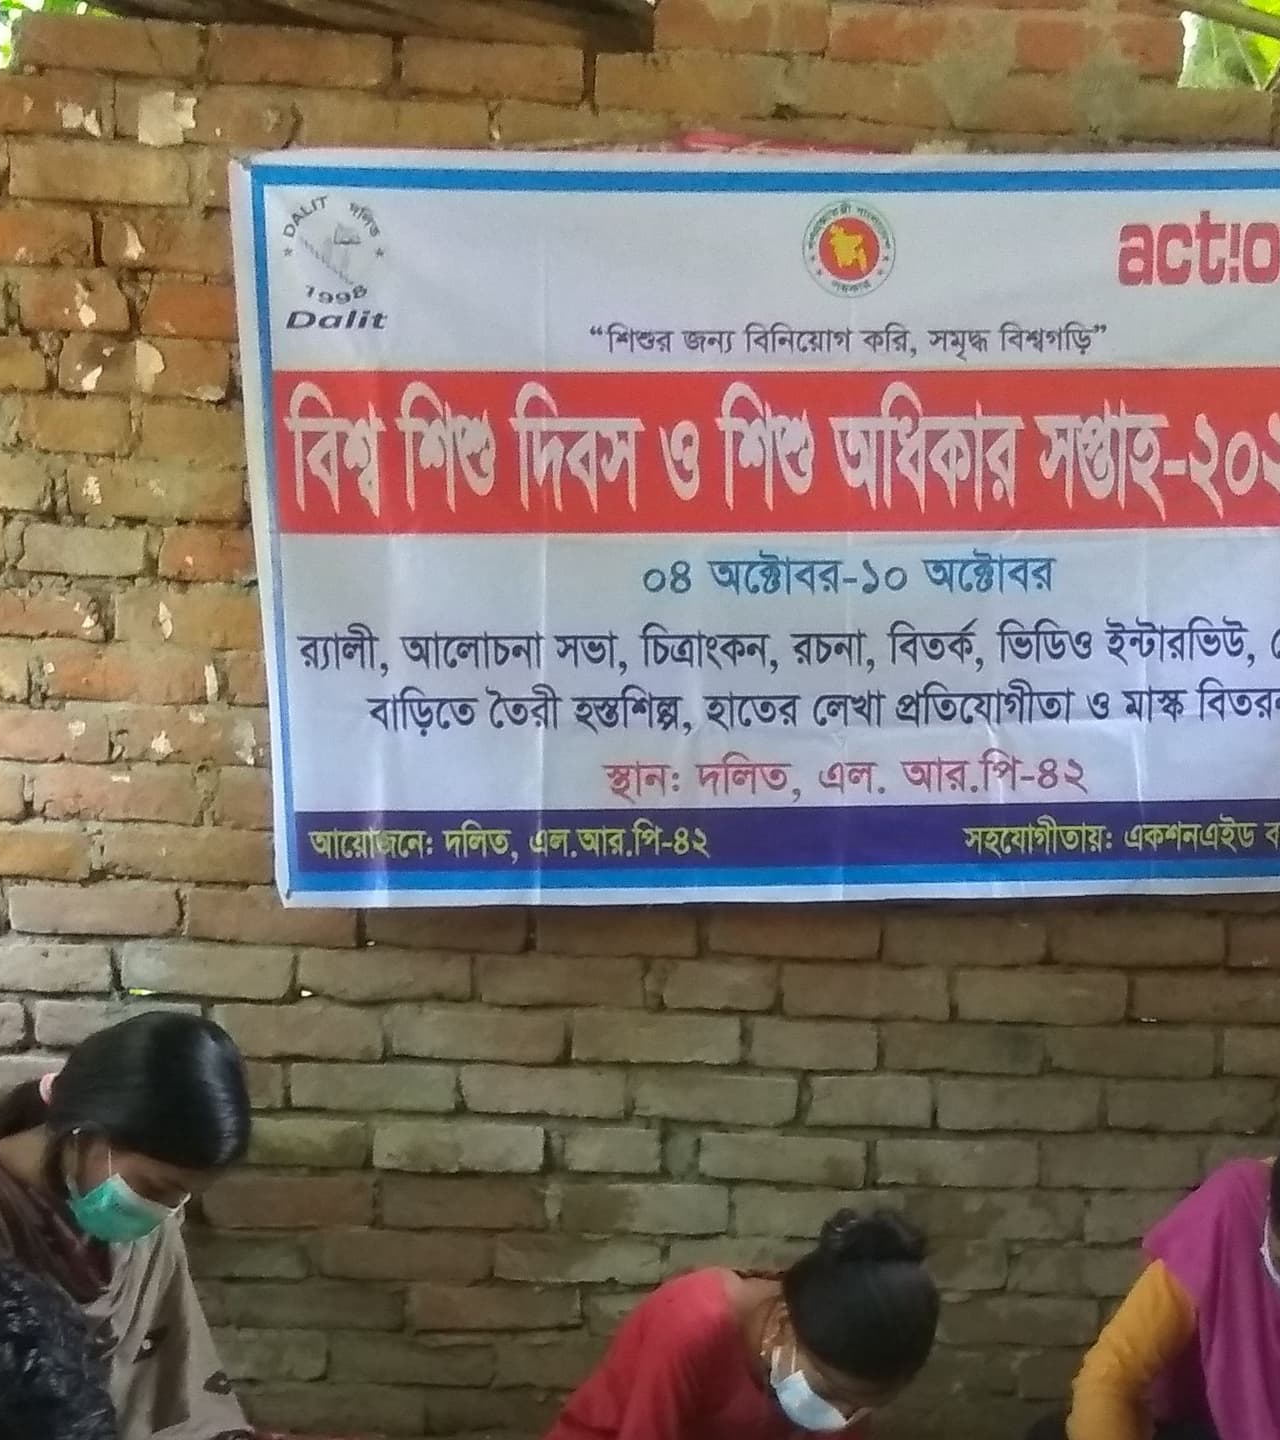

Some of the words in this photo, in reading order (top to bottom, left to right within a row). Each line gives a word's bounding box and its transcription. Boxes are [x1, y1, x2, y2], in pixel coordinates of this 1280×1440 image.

[282, 194, 328, 239] DALIT
[348, 201, 381, 238] দলিত
[307, 283, 367, 304] 1998
[286, 309, 388, 329] Dalit
[681, 330, 736, 353] জন্য
[743, 322, 853, 353] বিনিয়োগ
[859, 322, 916, 357] করি,
[928, 329, 991, 359] সমৃদ্ধ
[284, 383, 385, 517] বিশ্ব
[396, 383, 495, 512] শিশু
[509, 383, 645, 512] দিবস
[659, 420, 700, 500] ও
[715, 383, 814, 510] শিশু
[829, 382, 1024, 513] অধিকার
[643, 560, 691, 594] ০৪
[921, 549, 1057, 593] অক্টোবর
[399, 631, 545, 669] আলোচনা
[553, 630, 627, 676] সভা,
[638, 622, 778, 674] চিত্রাংকন,
[790, 628, 875, 673] রচনা,
[886, 618, 984, 672] বিতর্ক,
[996, 618, 1092, 663] ভিডিও
[1105, 616, 1255, 668] ইন্টারভিউ,
[366, 686, 479, 737] বাড়িতে
[485, 683, 563, 730] তৈরী
[571, 684, 692, 736] হস্তশিল্প,
[703, 691, 802, 732] হাতের
[813, 689, 886, 728] লেখা
[895, 678, 1076, 728] প্রতিযোগীতা
[1086, 692, 1109, 720] ও
[1121, 685, 1188, 723] মাস্ক
[602, 761, 680, 802] স্থান:
[695, 751, 801, 802] দলিত,
[309, 828, 432, 858] আয়োজনে:
[442, 821, 518, 863] দলিত,
[963, 815, 1112, 857] সহযোগীতায়:
[1125, 815, 1257, 851] একশনএইড
